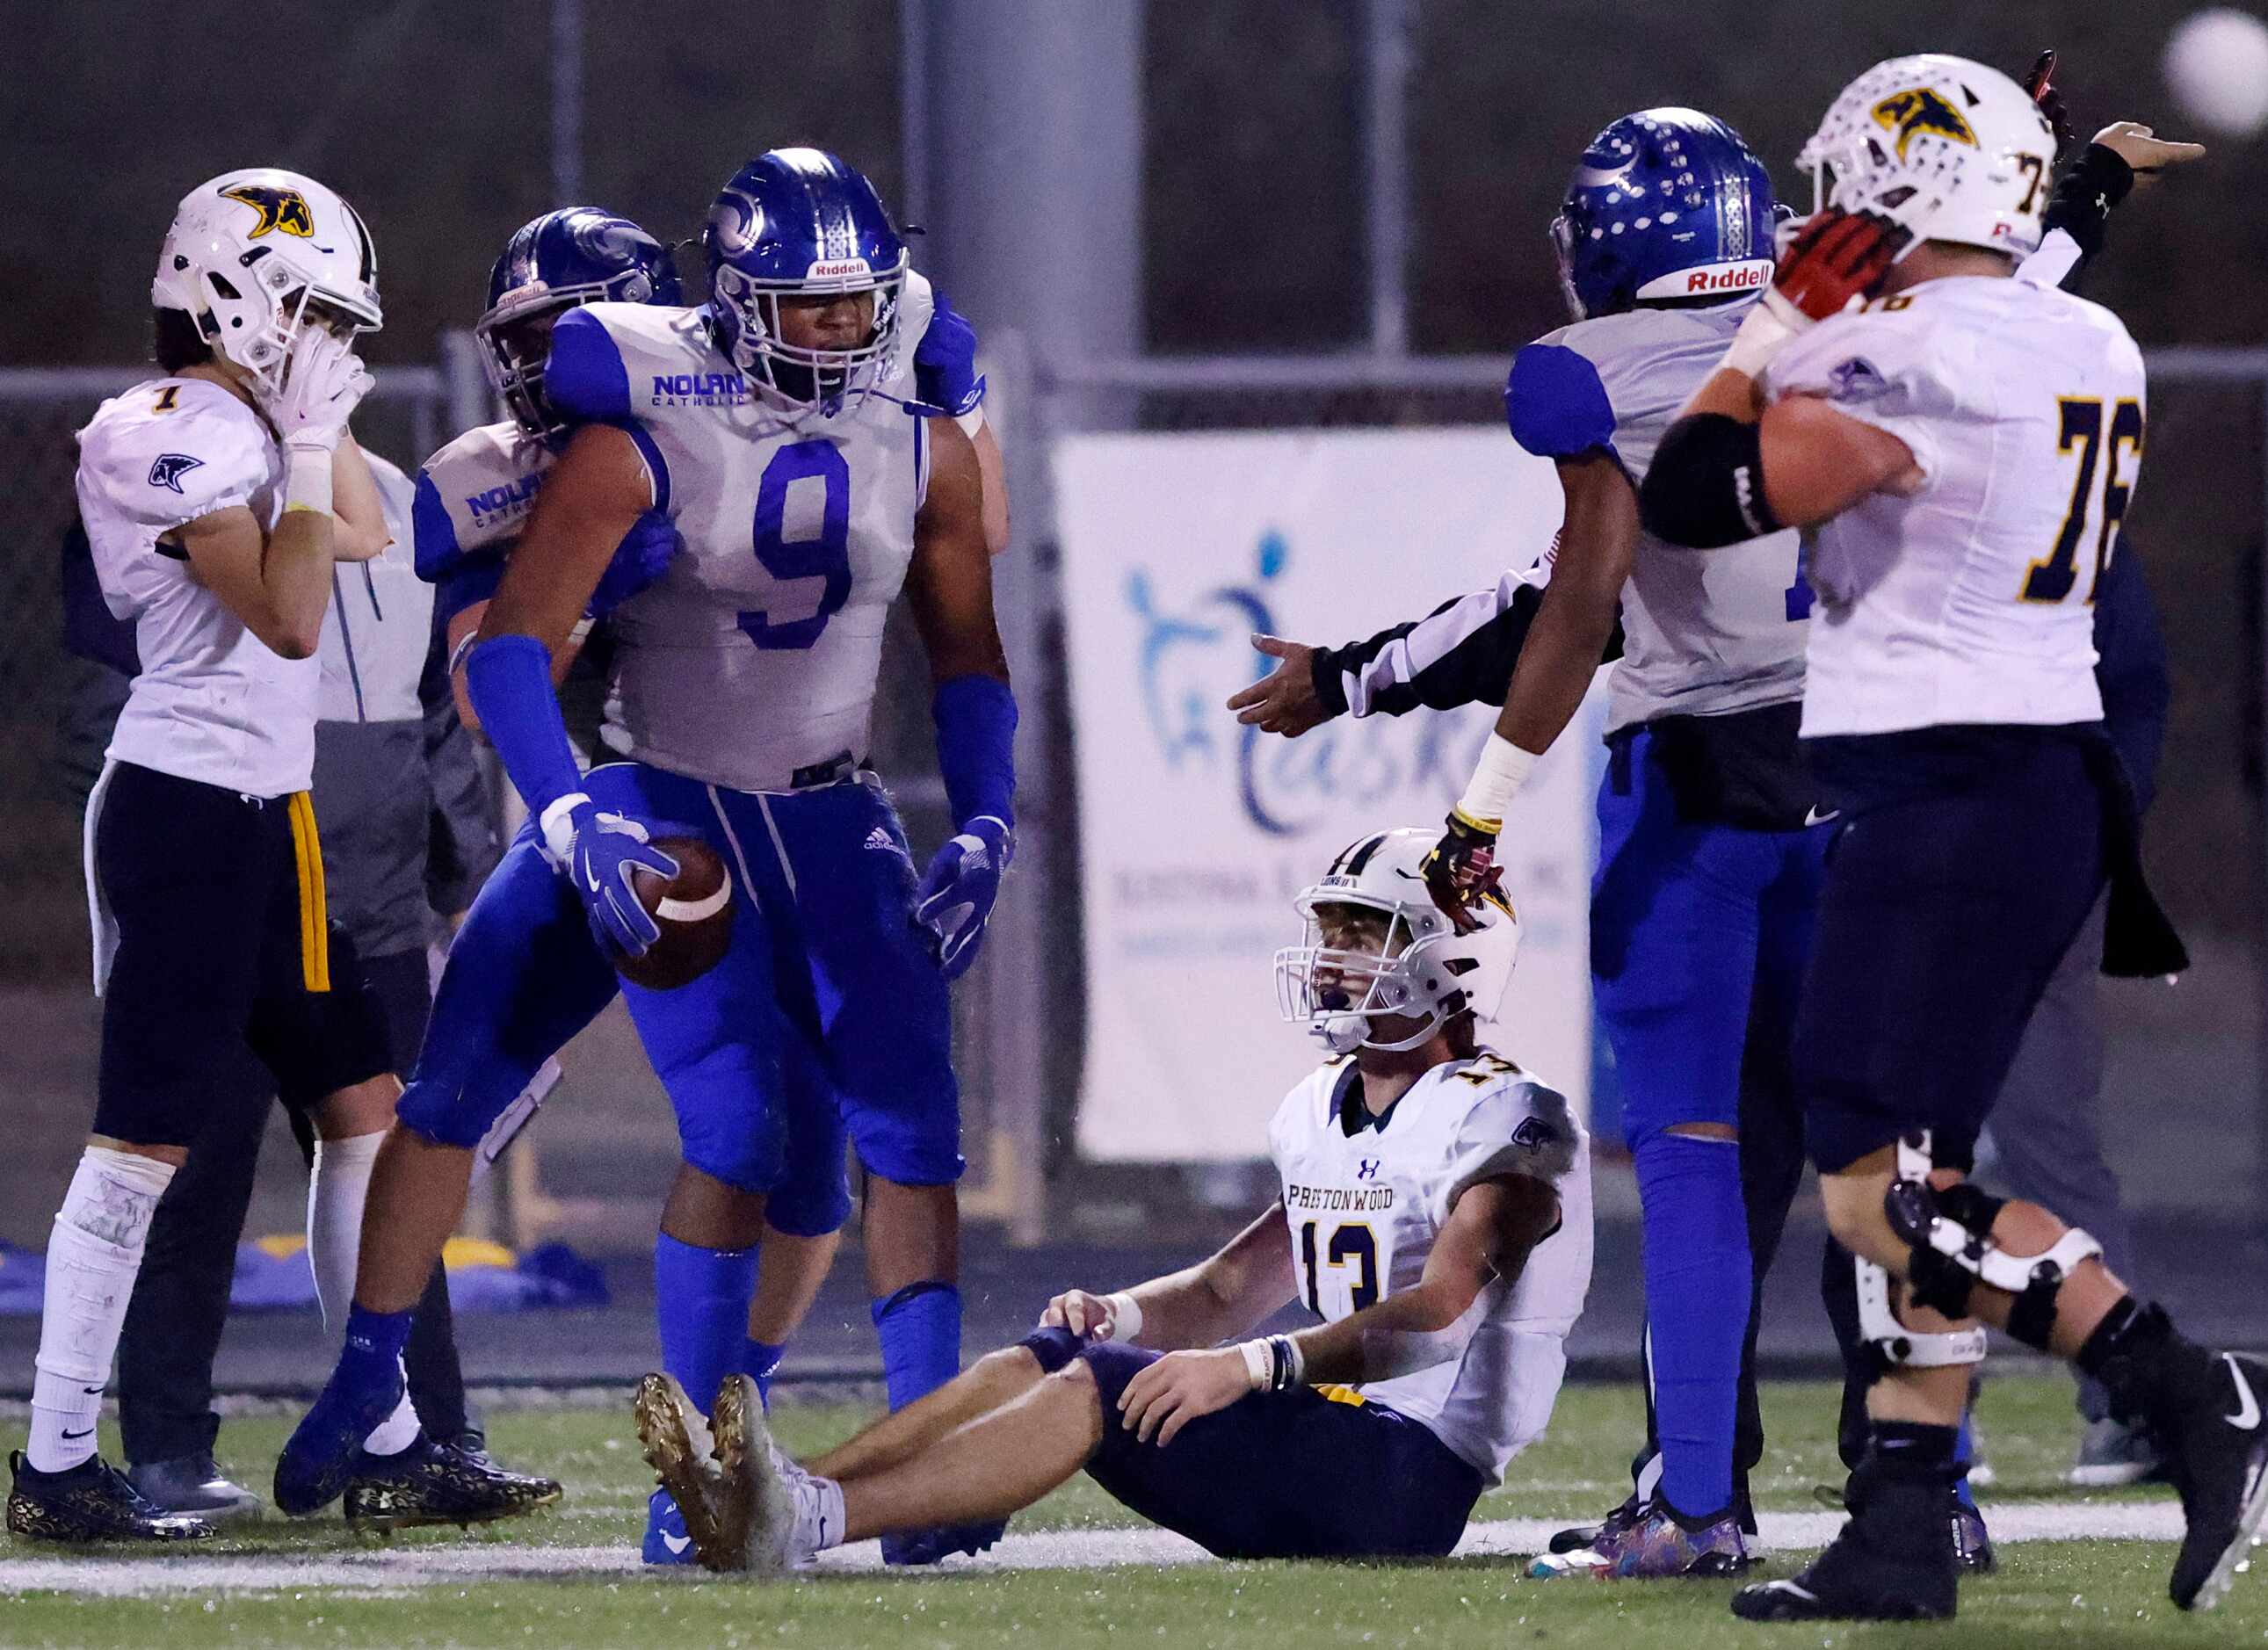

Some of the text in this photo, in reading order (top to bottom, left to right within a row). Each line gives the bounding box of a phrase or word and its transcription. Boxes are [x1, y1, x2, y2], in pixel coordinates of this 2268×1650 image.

[816, 263, 864, 276] Riddell
[1687, 264, 1770, 293] Riddell
[652, 373, 746, 395] NOLAN
[652, 395, 746, 407] CATHOLIC
[466, 474, 541, 517] NOLA
[736, 438, 853, 650] 9
[1301, 1219, 1382, 1322] 13
